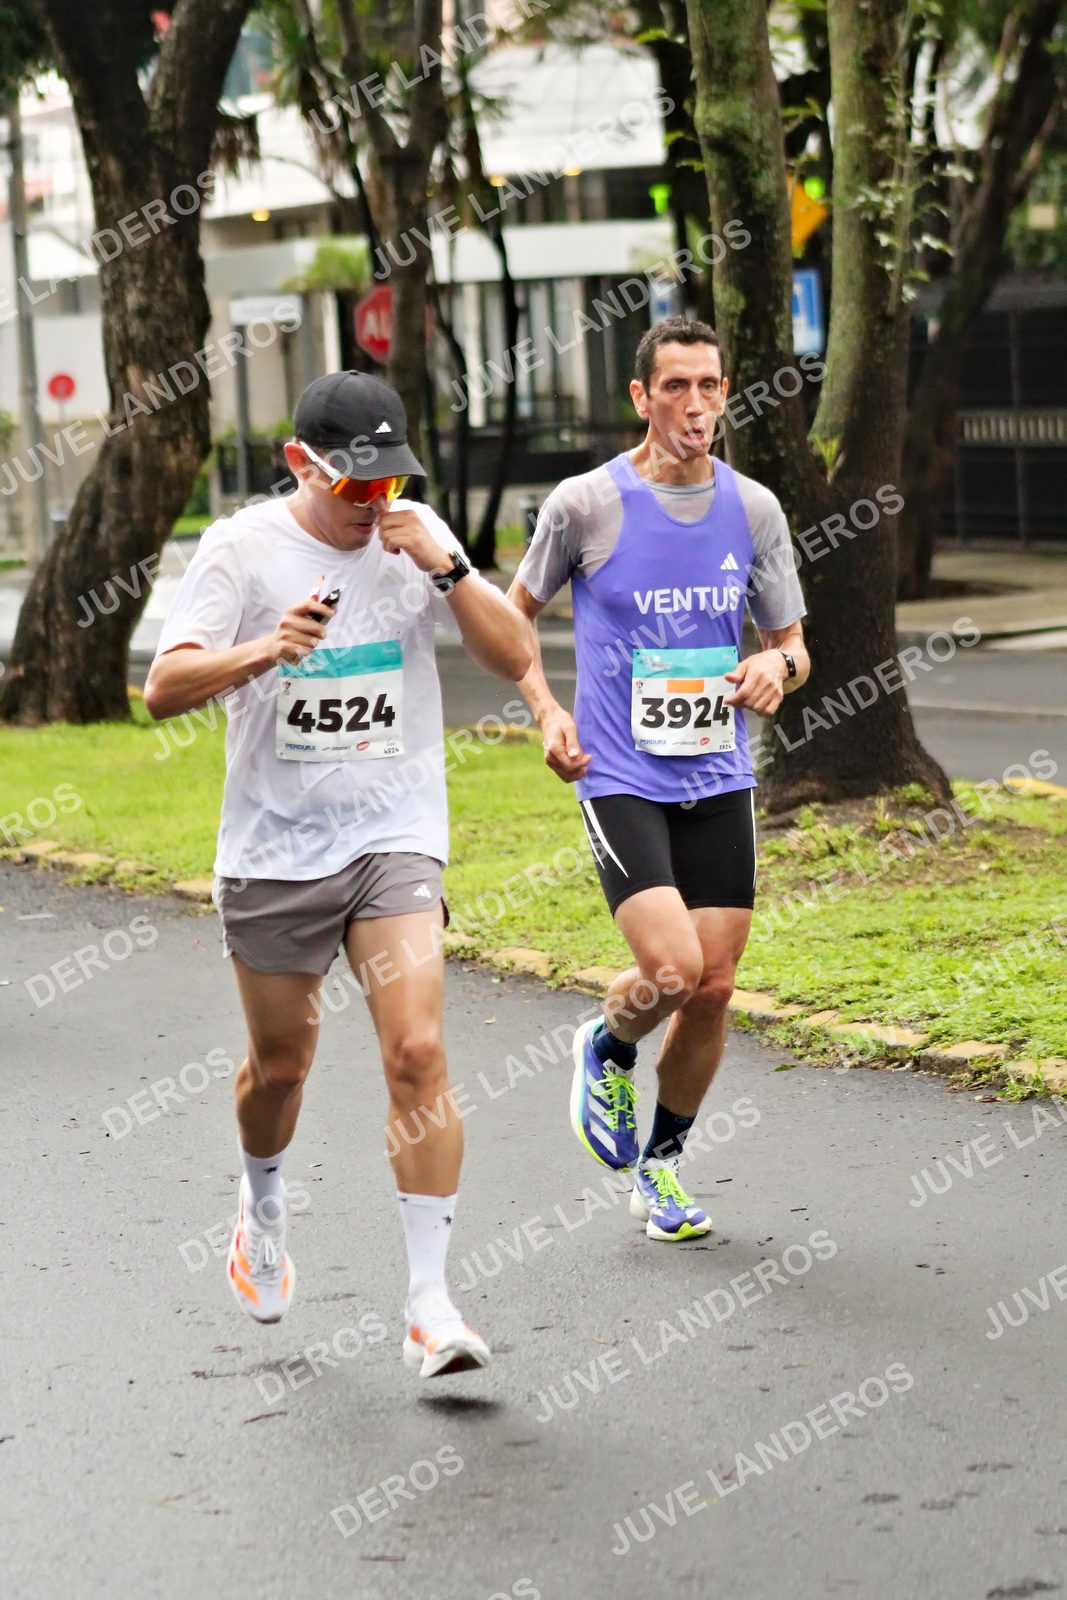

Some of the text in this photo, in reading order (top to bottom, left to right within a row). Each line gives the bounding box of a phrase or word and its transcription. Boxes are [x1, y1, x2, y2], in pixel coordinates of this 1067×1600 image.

[633, 585, 740, 615] VENTUS
[287, 693, 396, 733] 4524
[640, 695, 730, 729] 3924
